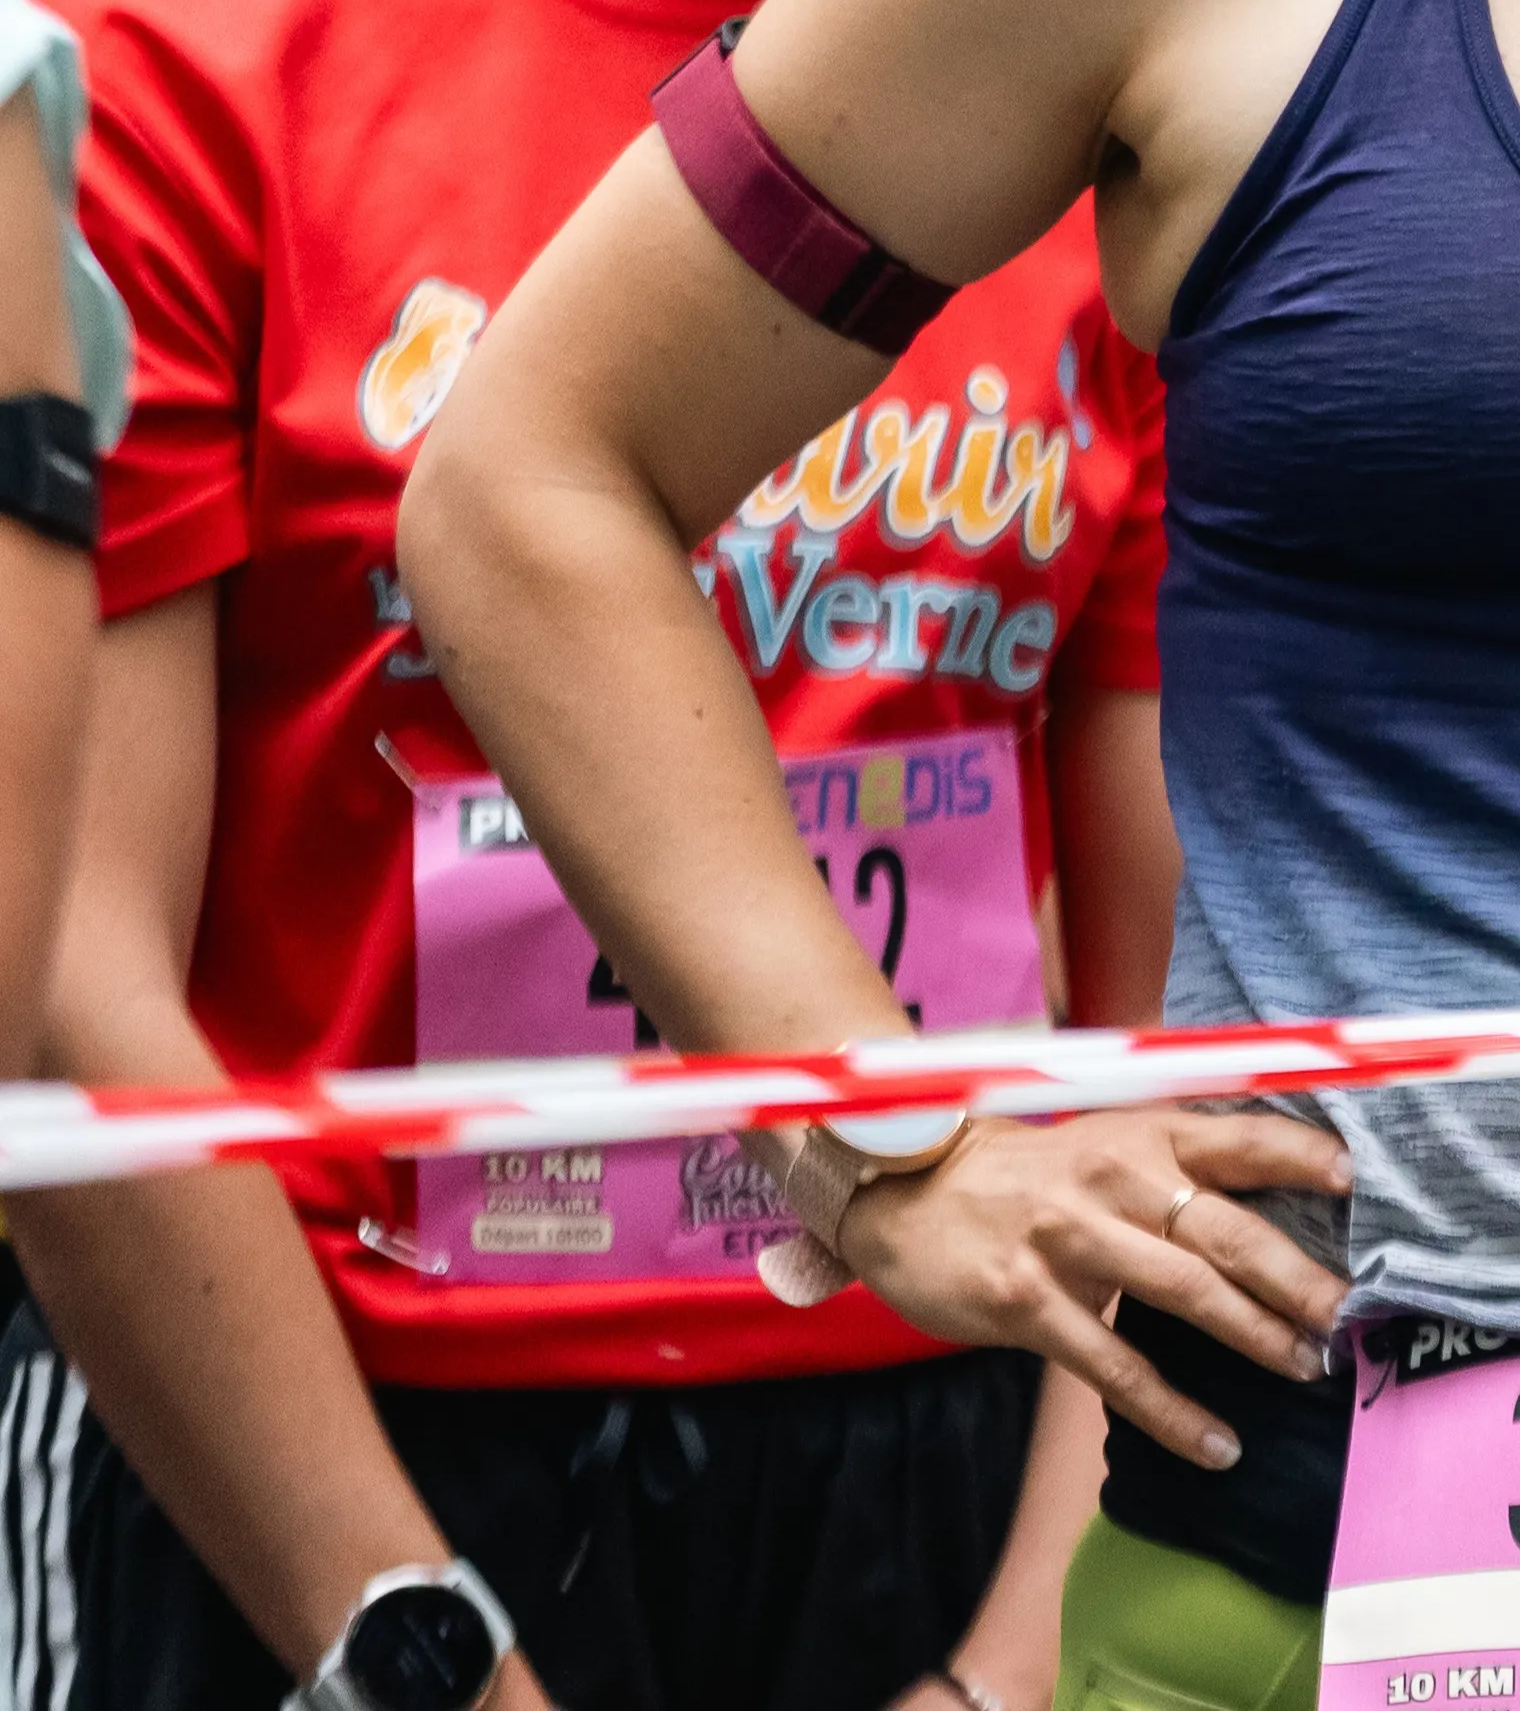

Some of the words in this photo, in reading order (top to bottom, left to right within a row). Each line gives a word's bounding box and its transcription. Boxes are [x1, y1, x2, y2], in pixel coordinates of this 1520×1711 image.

[717, 531, 1060, 693] Verne
[483, 1152, 530, 1184] 10
[540, 1150, 603, 1183] KM
[1386, 1672, 1437, 1705] 10
[1446, 1665, 1516, 1699] KM
